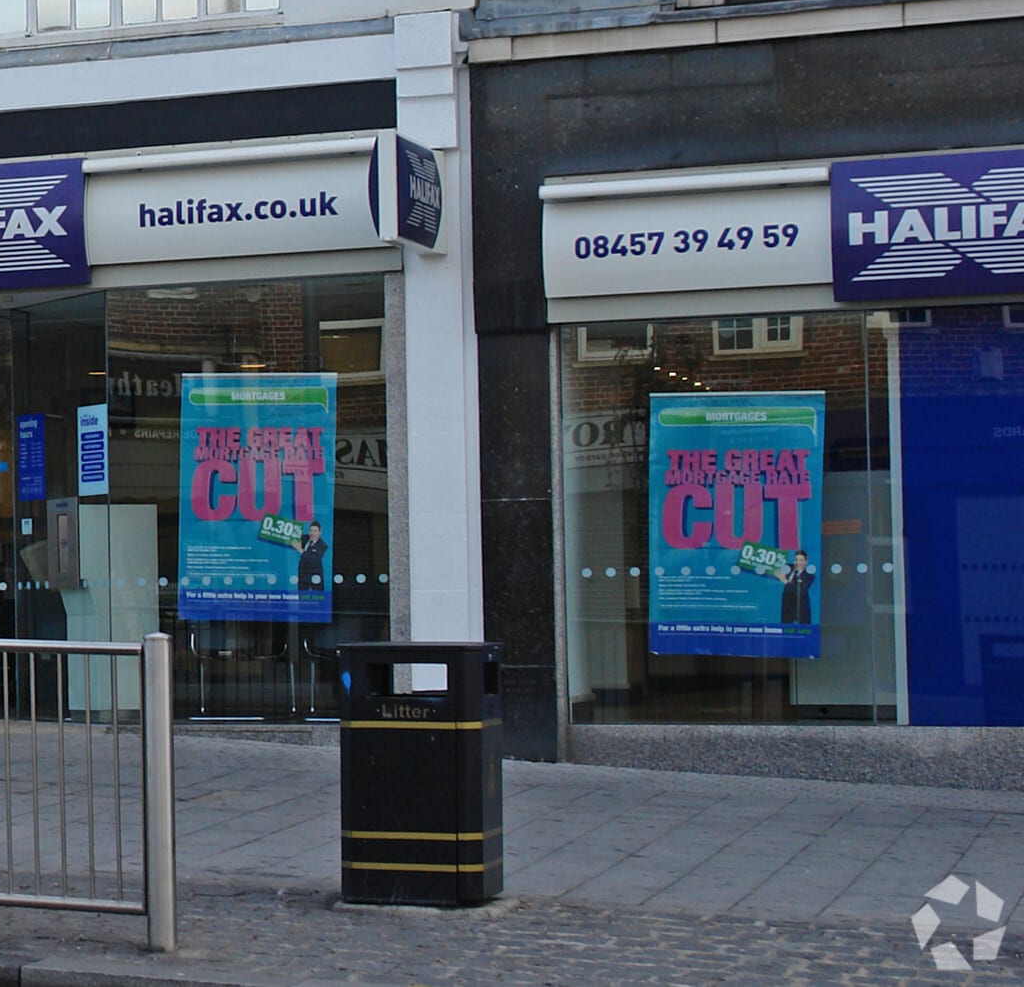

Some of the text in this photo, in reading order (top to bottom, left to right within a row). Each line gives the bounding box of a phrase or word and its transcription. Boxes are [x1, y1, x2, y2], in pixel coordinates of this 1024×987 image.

[409, 174, 440, 209] HALIFAX
[139, 191, 338, 228] halifax.co.uk
[848, 200, 1024, 247] HALIFA
[574, 223, 799, 259] 08457 39 49 59
[231, 391, 286, 401] MORTGAGES
[705, 411, 767, 421] MORTGAGES
[196, 427, 241, 448] THE
[247, 426, 323, 448] GREAT
[194, 447, 323, 461] MORTGAGE RATE
[666, 449, 717, 471] THE
[724, 449, 810, 471] GREAT
[664, 470, 811, 486] MORTGAGE RATE
[191, 460, 325, 521] CUT
[662, 483, 812, 550] CUT
[381, 704, 430, 719] Litter
